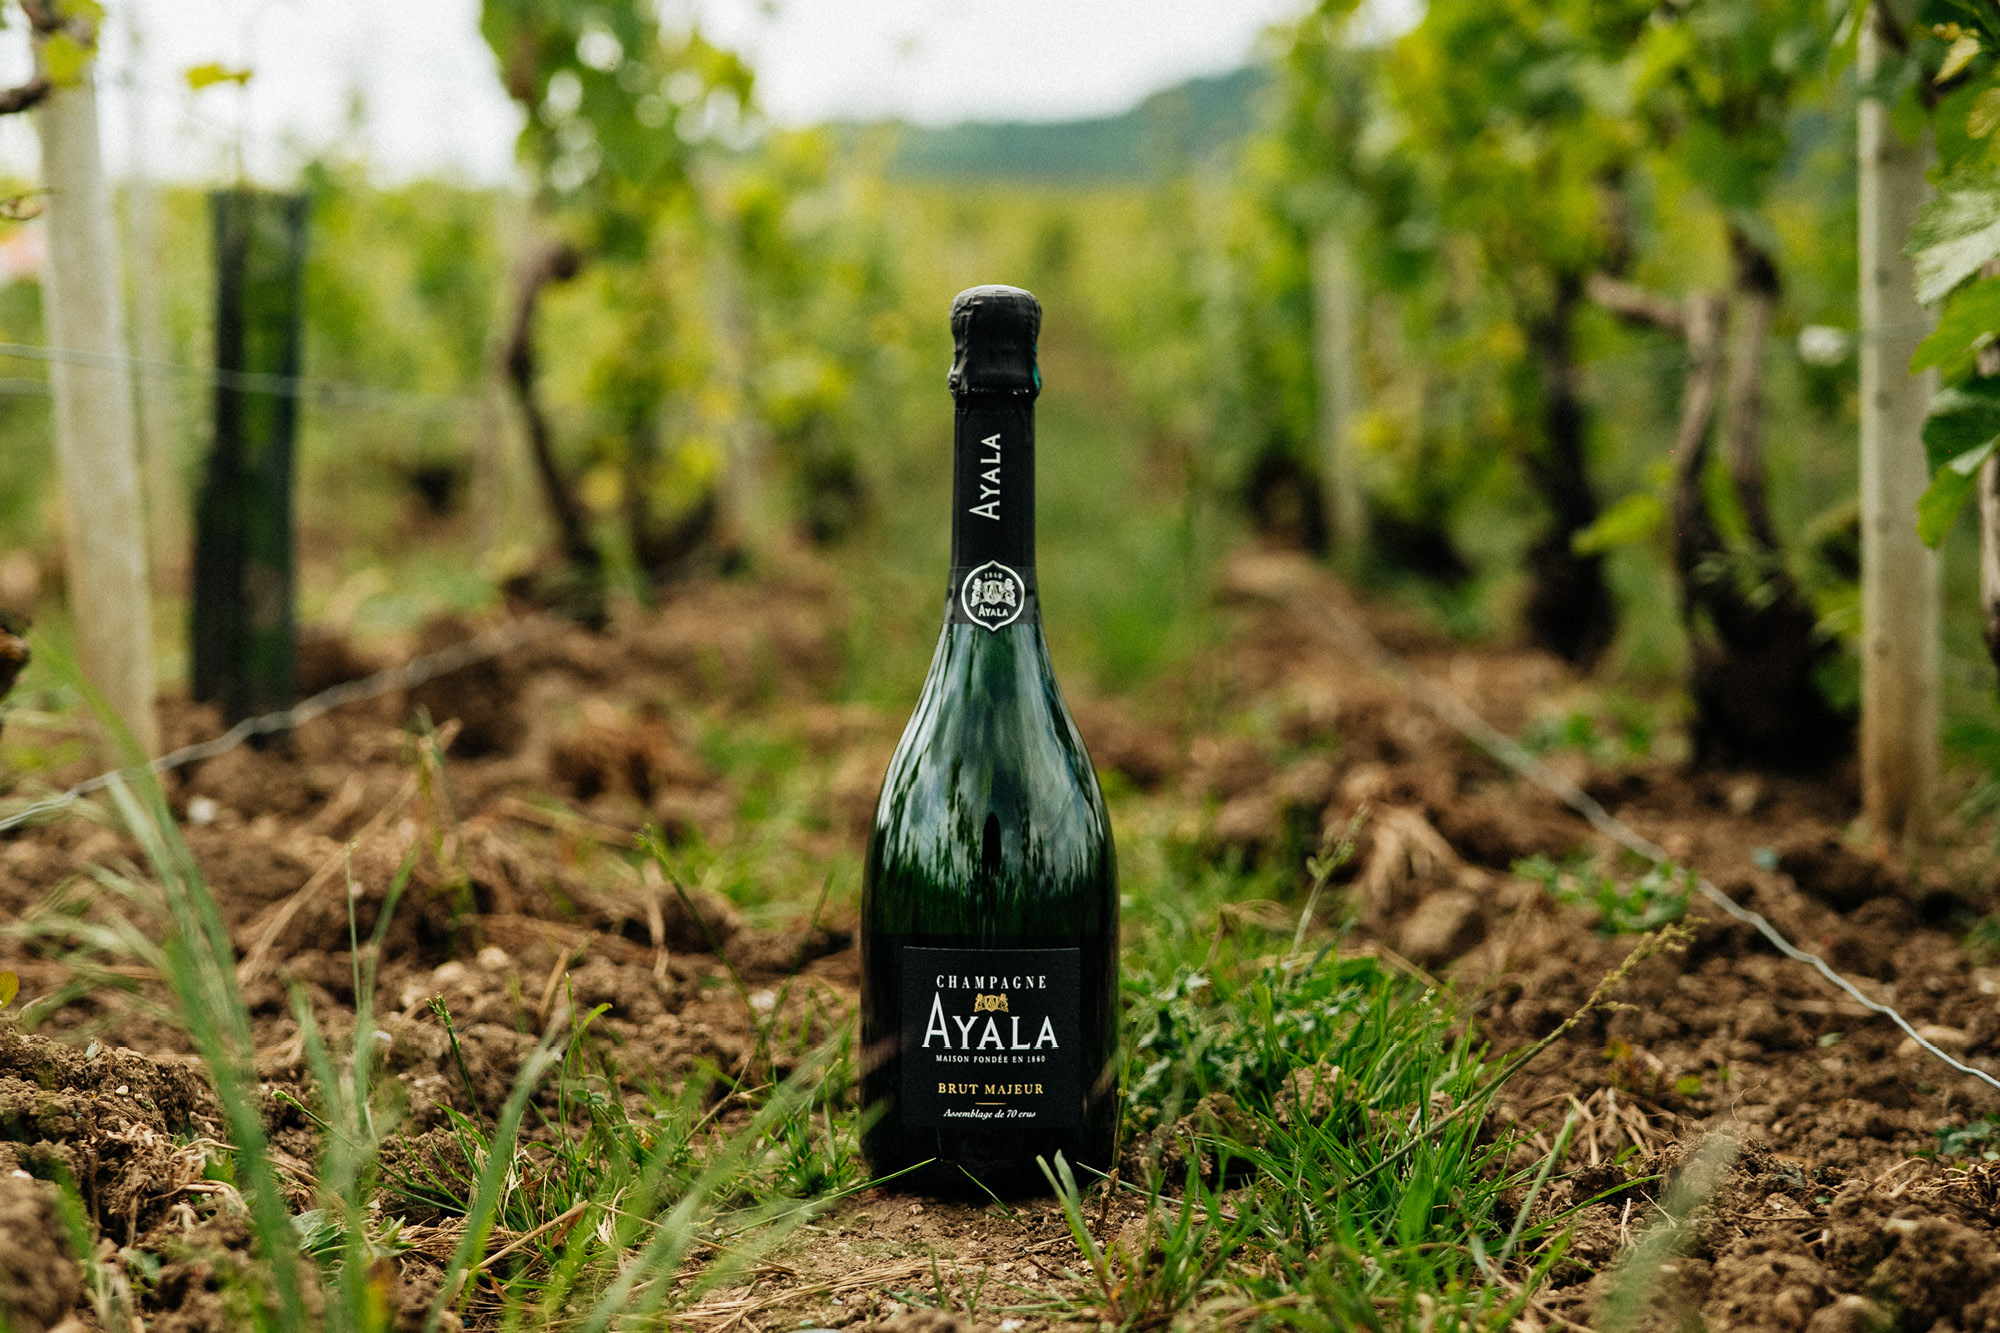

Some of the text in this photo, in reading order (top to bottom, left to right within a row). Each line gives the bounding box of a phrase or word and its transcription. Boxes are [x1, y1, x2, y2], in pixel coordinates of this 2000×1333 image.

[969, 433, 1001, 521] AYALA
[978, 604, 1009, 617] AYALA
[936, 974, 1047, 989] CHAMPAGNE
[921, 991, 1060, 1050] AYALA
[935, 1053, 1046, 1064] MAISON FONDÉE EN 1860
[938, 1082, 1044, 1095] BRUT MAJEUR
[943, 1108, 993, 1120] Assemblage
[994, 1109, 1005, 1118] de
[1006, 1109, 1018, 1118] 70
